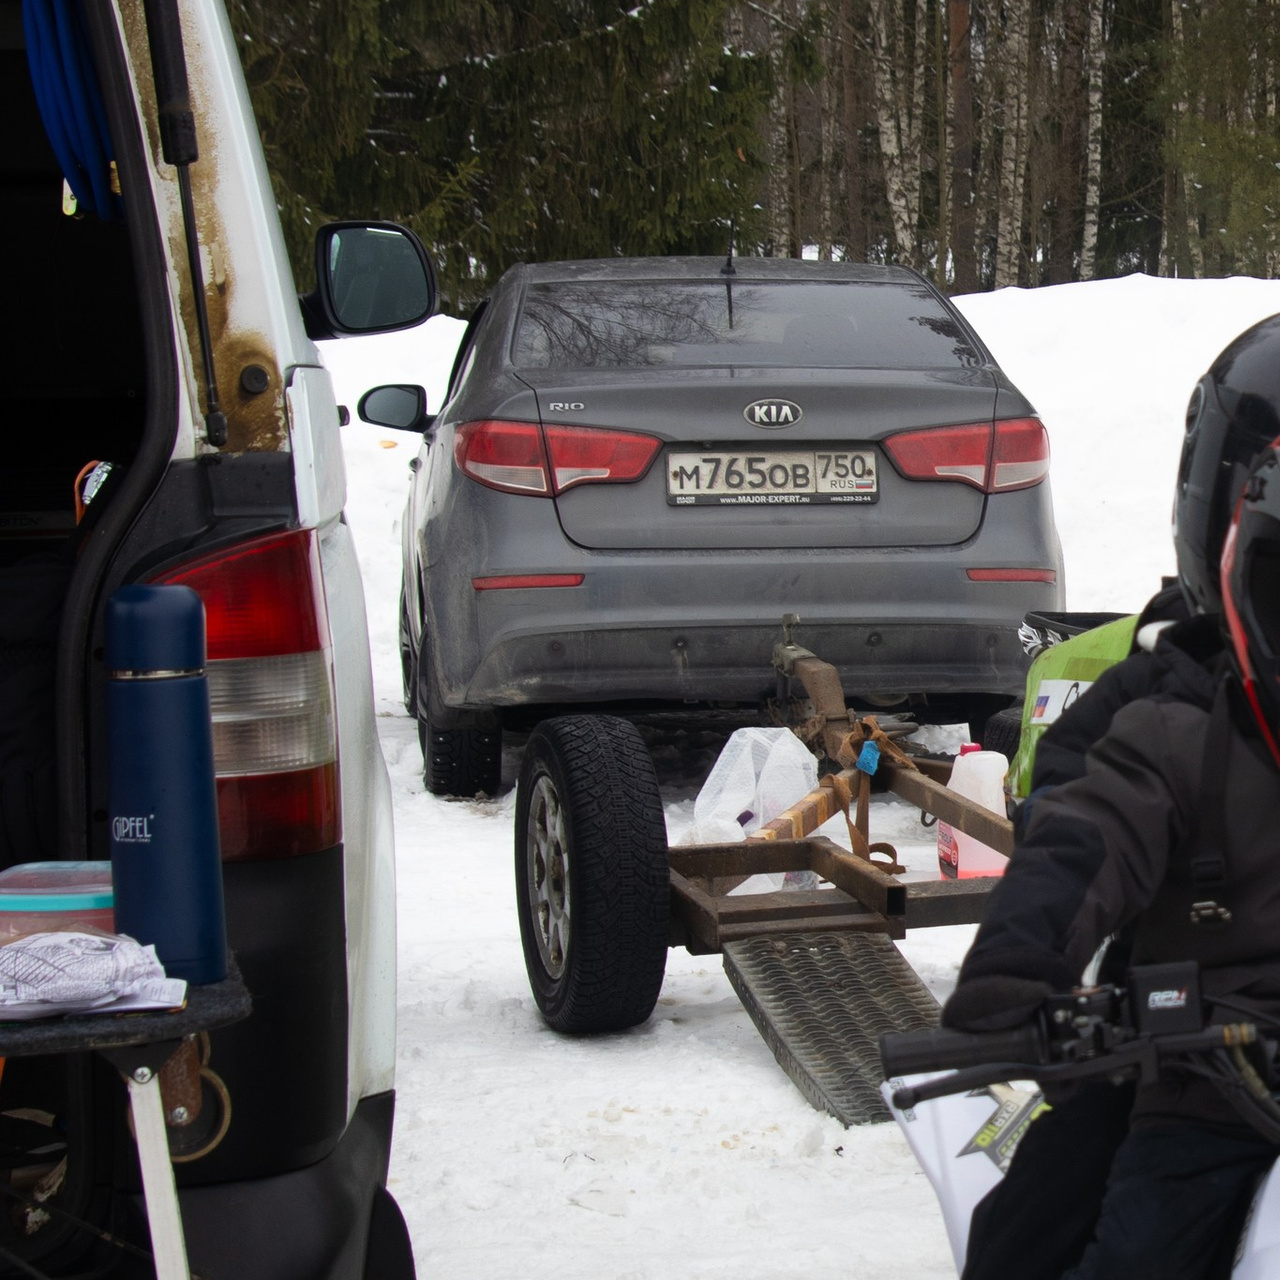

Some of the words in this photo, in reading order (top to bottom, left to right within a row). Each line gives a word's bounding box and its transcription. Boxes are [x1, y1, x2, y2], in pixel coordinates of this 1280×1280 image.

[549, 401, 585, 412] RIO
[753, 404, 795, 423] KIA
[816, 454, 867, 479] 750
[830, 479, 855, 489] RUS
